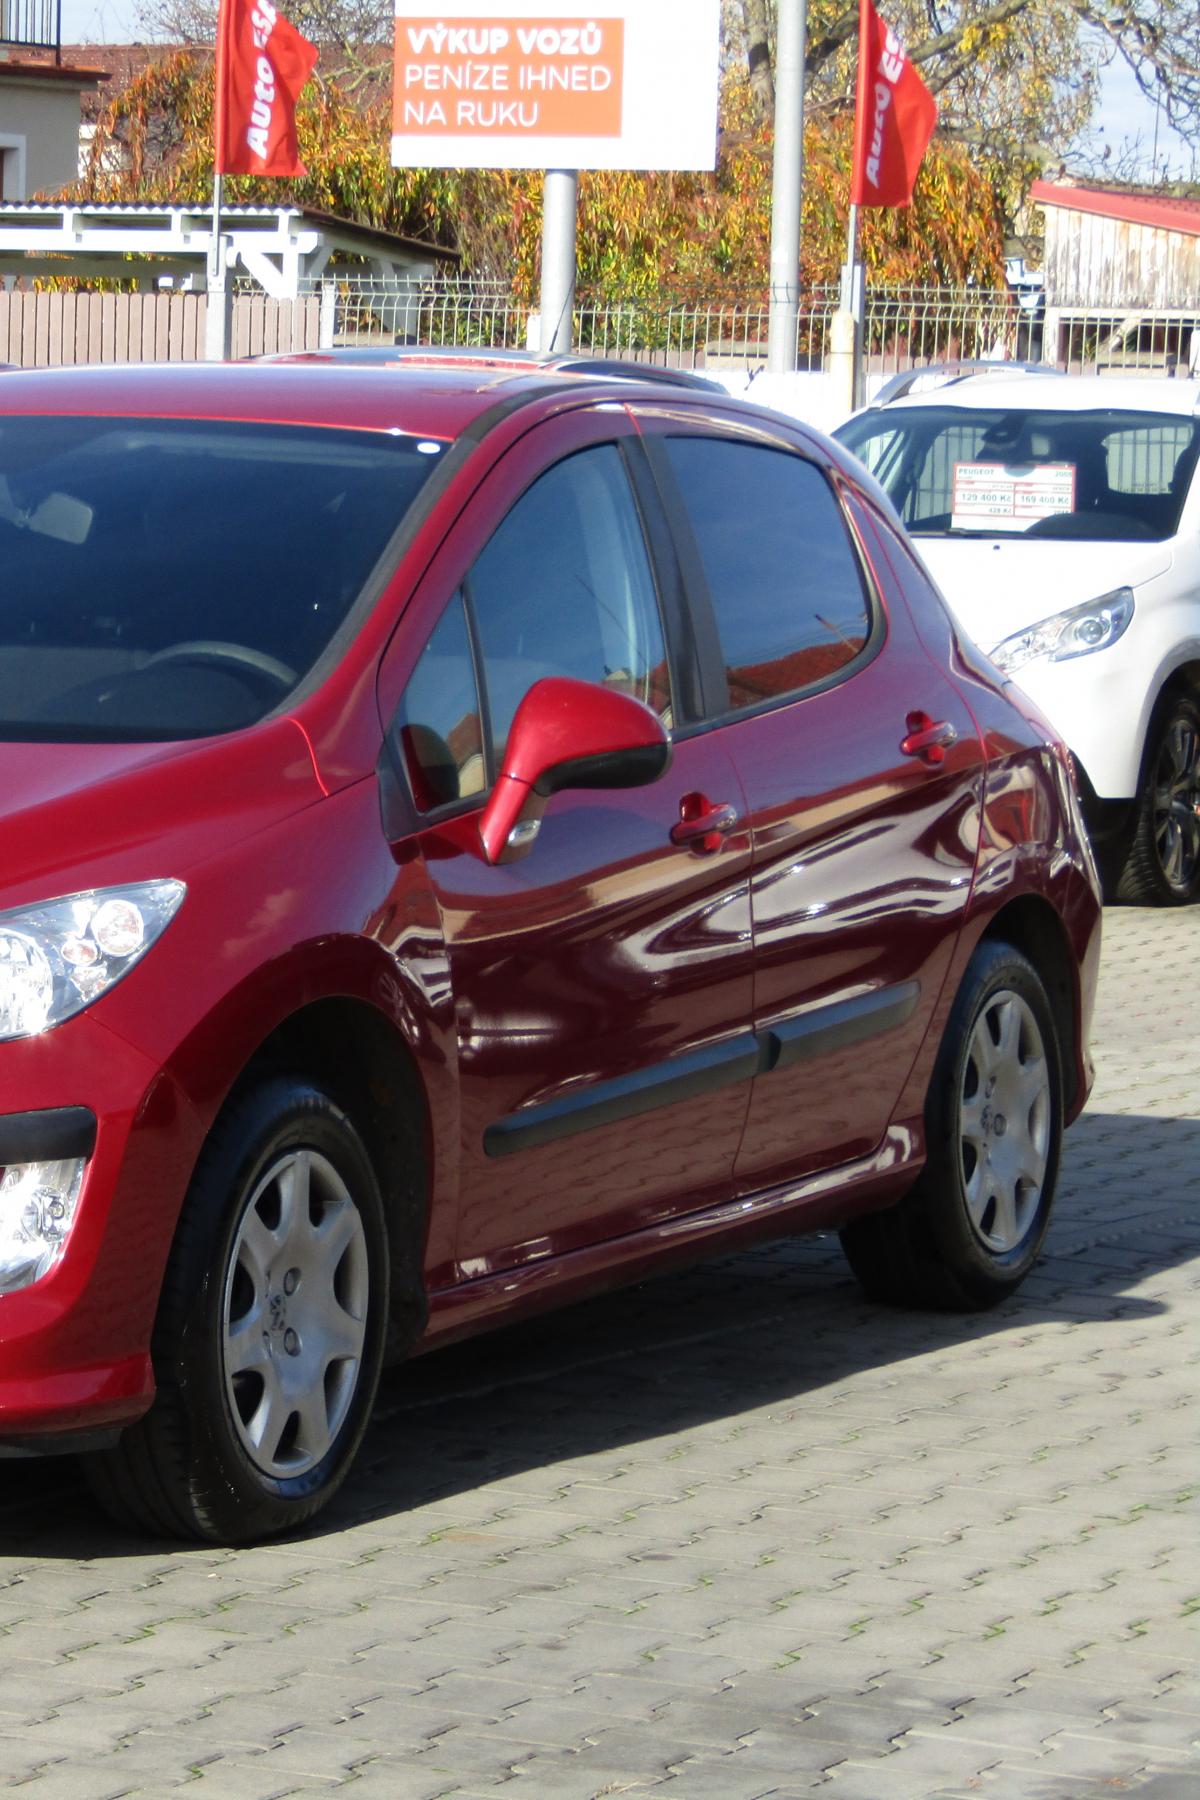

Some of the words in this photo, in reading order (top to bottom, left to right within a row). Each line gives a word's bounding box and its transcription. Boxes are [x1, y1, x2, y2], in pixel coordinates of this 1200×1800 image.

[407, 22, 509, 55] VÝKUP
[516, 21, 603, 56] VOZŮ
[404, 60, 509, 91] PENÍZE
[519, 65, 612, 92] IHNED
[246, 56, 276, 160] Auto
[404, 101, 447, 126] NA
[456, 101, 539, 128] RUKU
[958, 467, 995, 476] PEUGEOT
[980, 493, 997, 502] 400
[999, 494, 1012, 503] Kč
